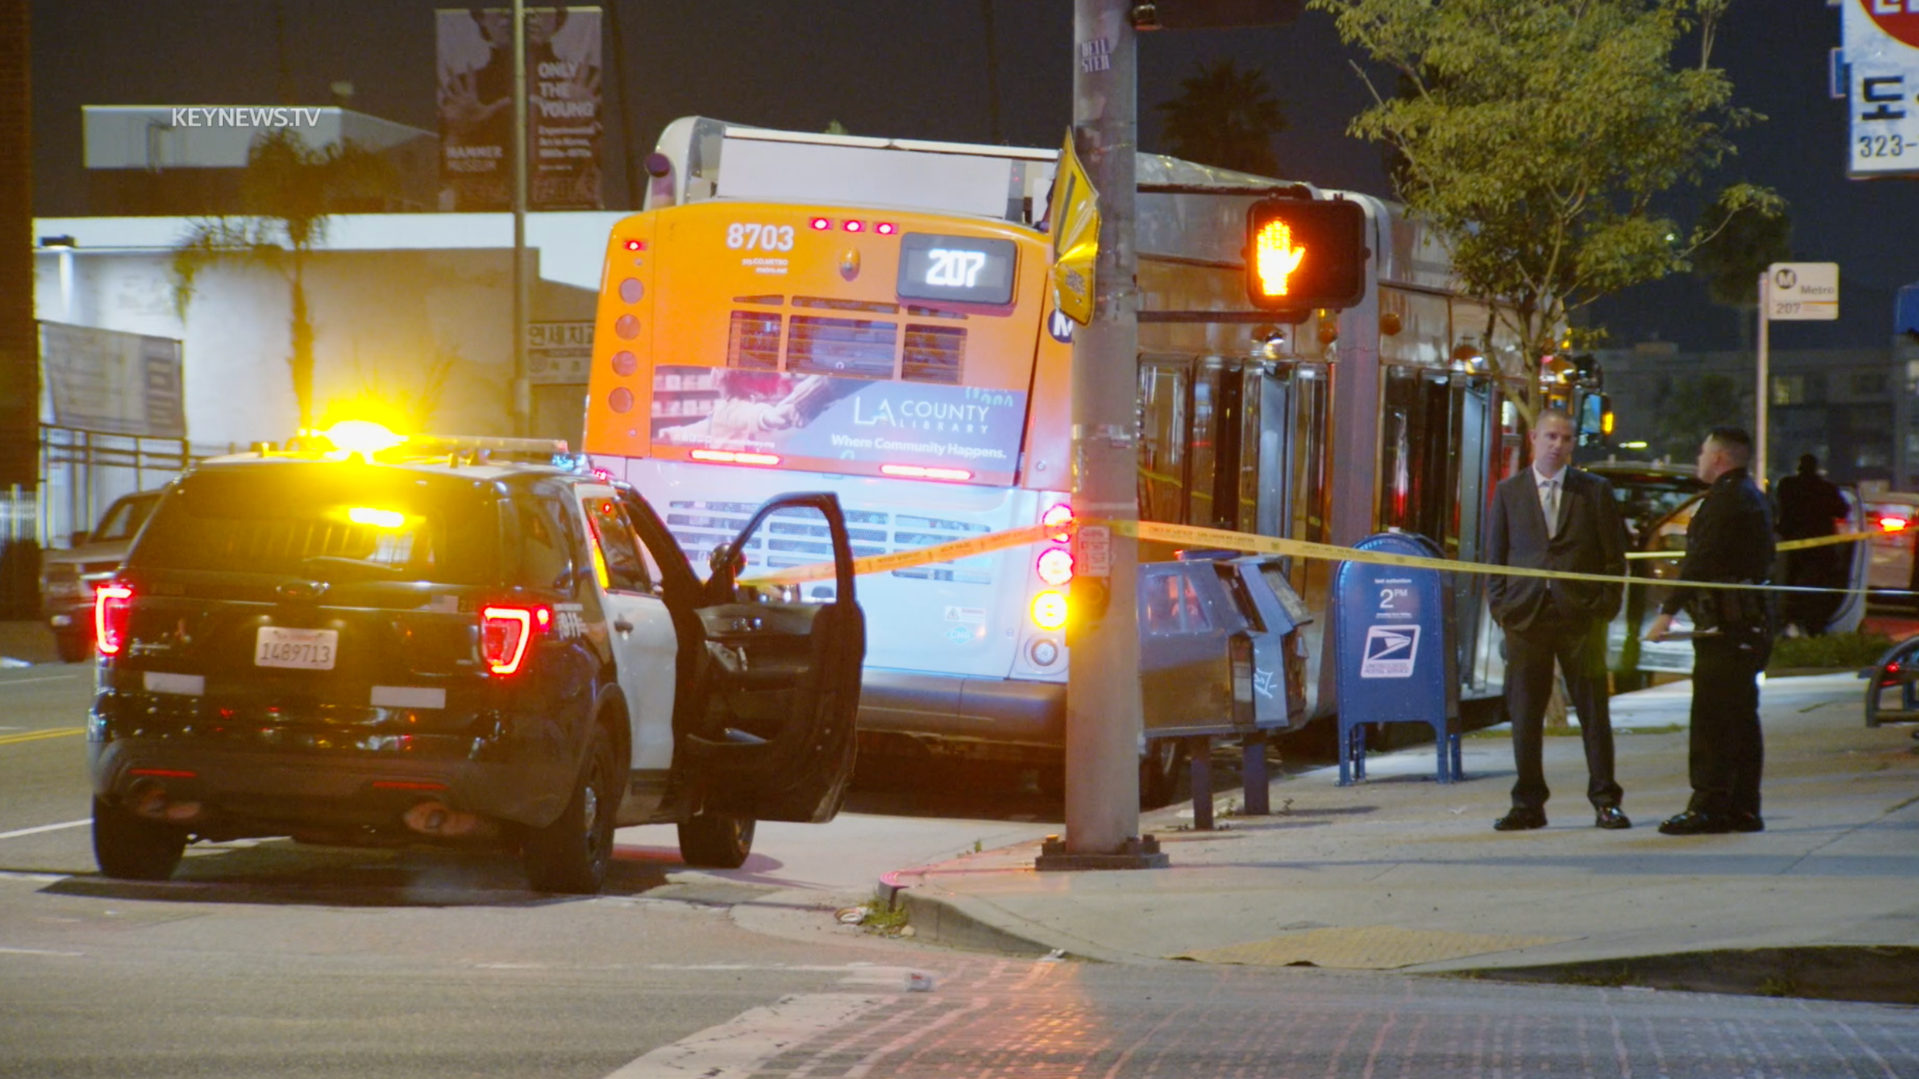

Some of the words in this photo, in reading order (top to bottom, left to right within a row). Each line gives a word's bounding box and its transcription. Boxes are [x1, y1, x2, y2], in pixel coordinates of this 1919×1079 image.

[538, 61, 578, 79] ONLY
[538, 81, 569, 98] THE
[540, 102, 595, 118] YOUNG
[726, 222, 794, 252] 8703
[925, 249, 987, 288] 207
[1800, 285, 1835, 295] Metro
[1776, 302, 1801, 315] 207
[854, 396, 896, 427] LA
[901, 400, 990, 422] COUNTY
[900, 419, 989, 435] LIBRARY
[832, 433, 873, 449] Where
[874, 437, 948, 457] Community
[948, 442, 1007, 460] Happens.
